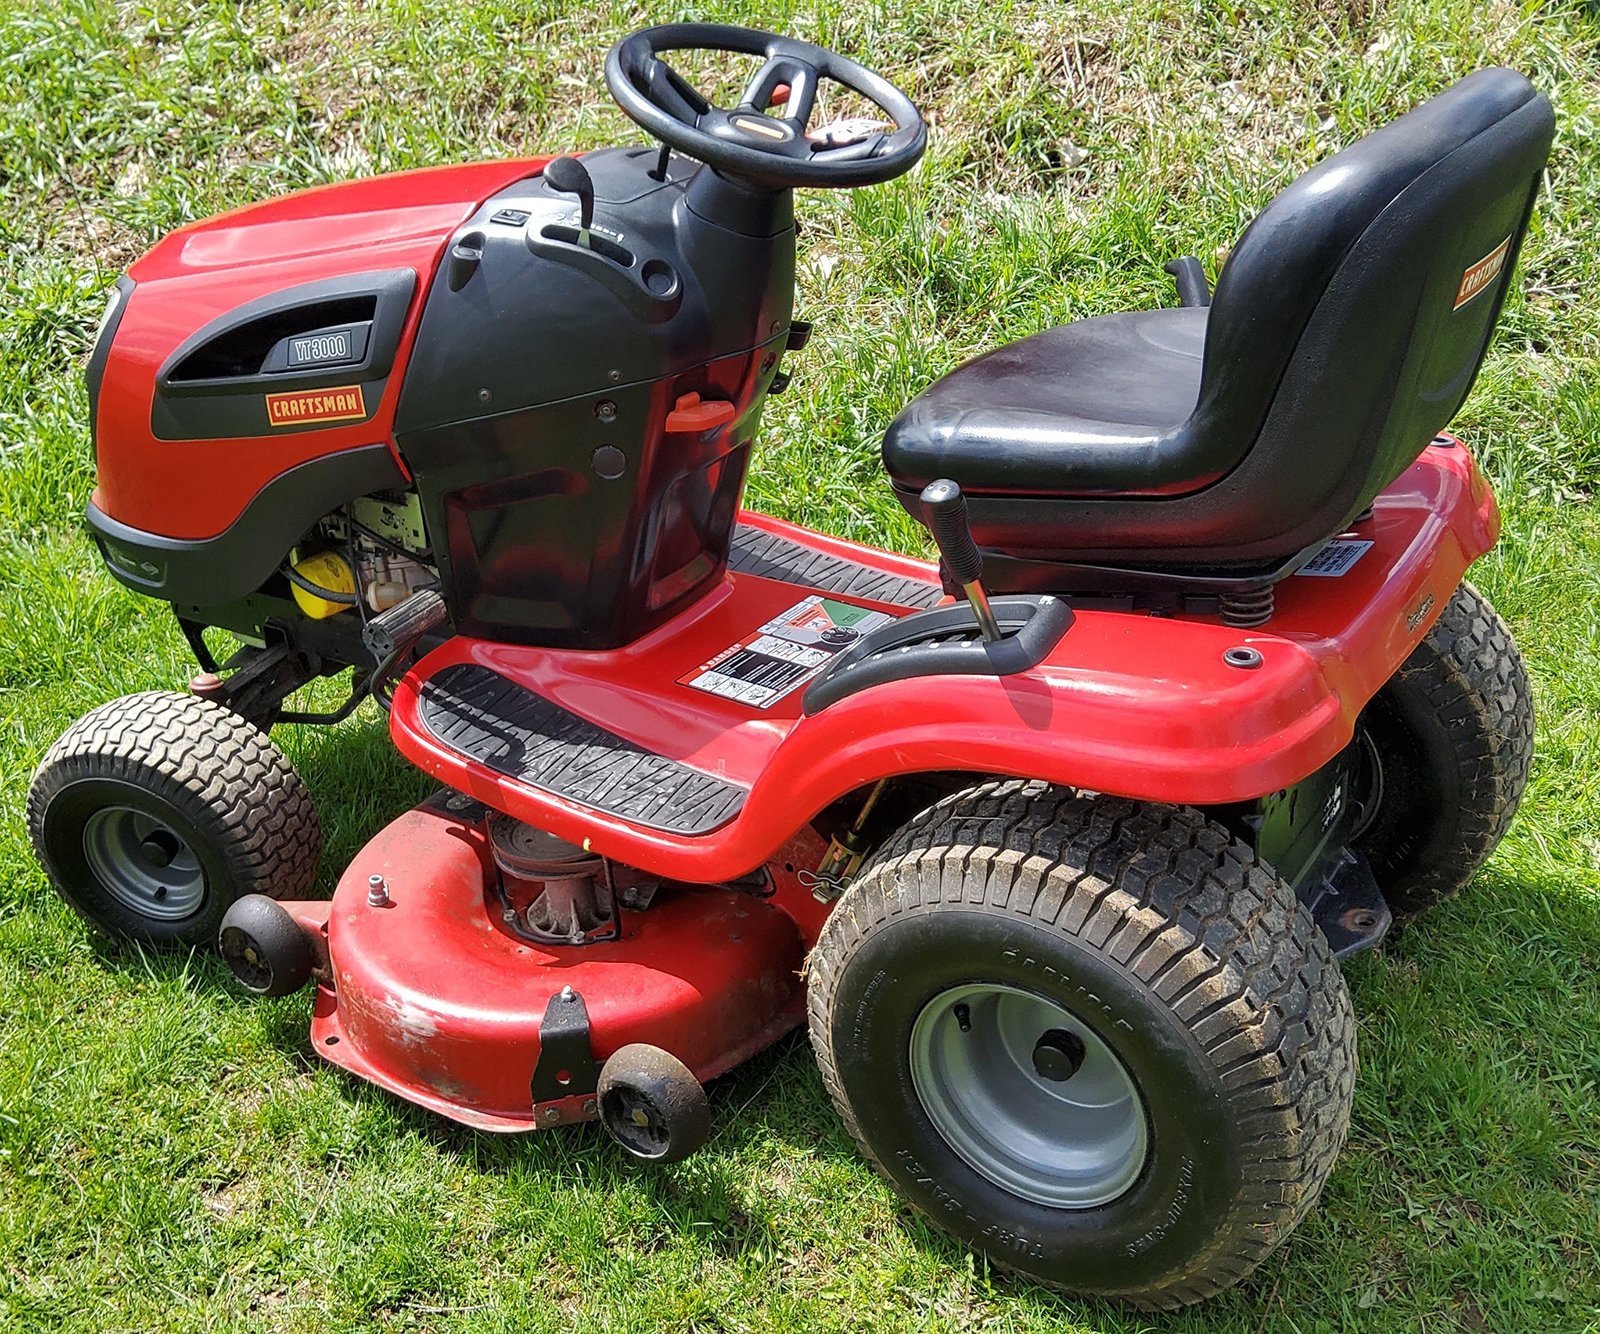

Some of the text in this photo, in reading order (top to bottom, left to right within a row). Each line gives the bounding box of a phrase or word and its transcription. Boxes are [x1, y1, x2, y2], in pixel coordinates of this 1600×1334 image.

[295, 335, 346, 361] YT3000
[273, 393, 357, 418] CRAFTSMAN
[707, 643, 744, 666] DANGER
